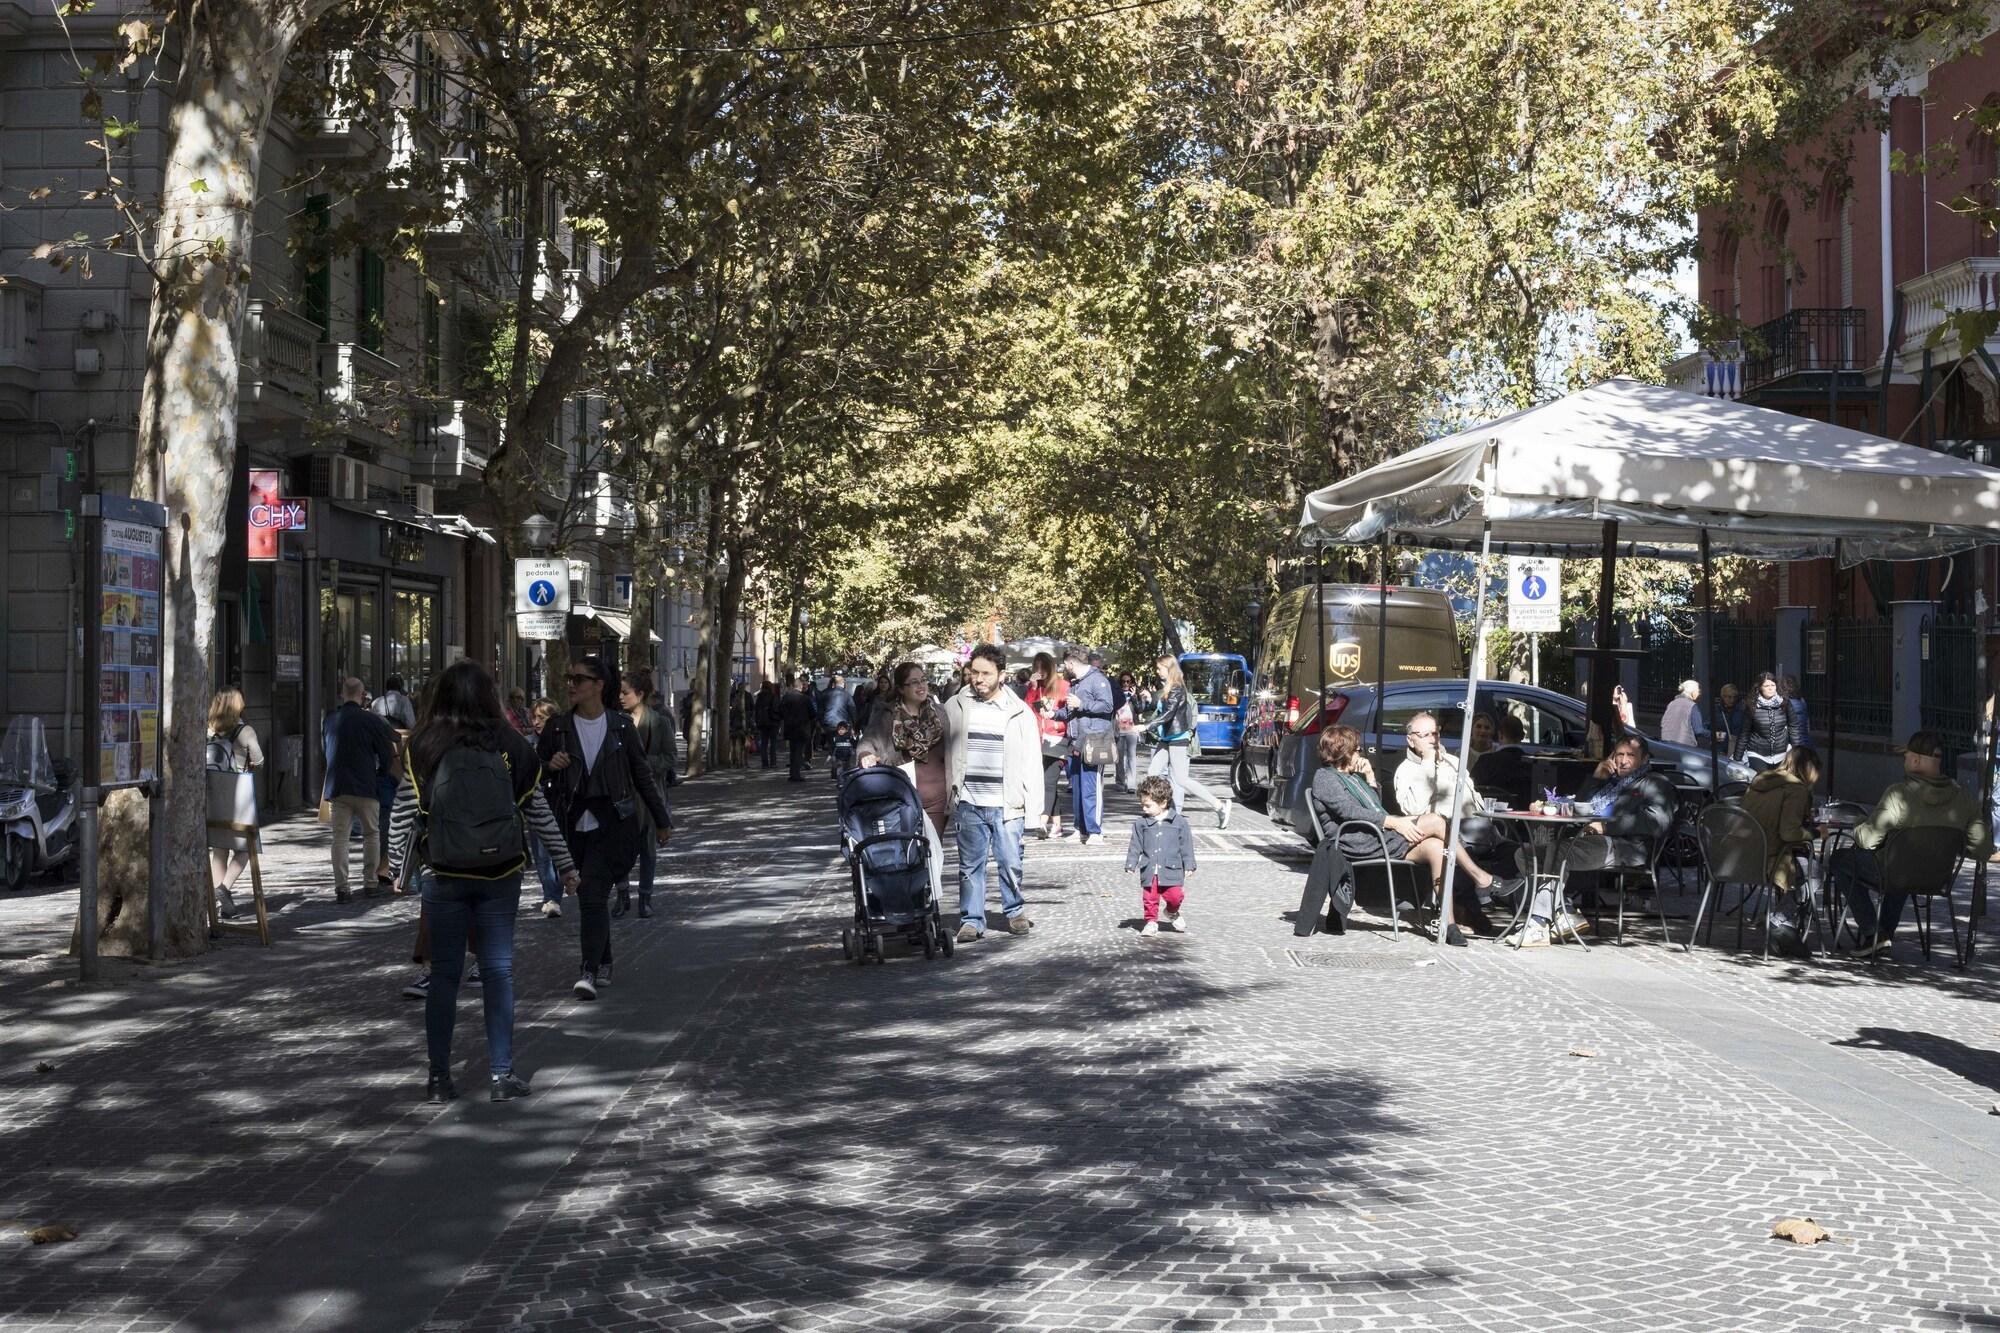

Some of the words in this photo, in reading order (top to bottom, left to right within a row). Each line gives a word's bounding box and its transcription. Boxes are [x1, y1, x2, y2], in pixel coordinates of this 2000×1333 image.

[124, 527, 153, 544] AUGUSTEO
[1332, 653, 1358, 673] ups
[1398, 664, 1437, 673] www.ups.com
